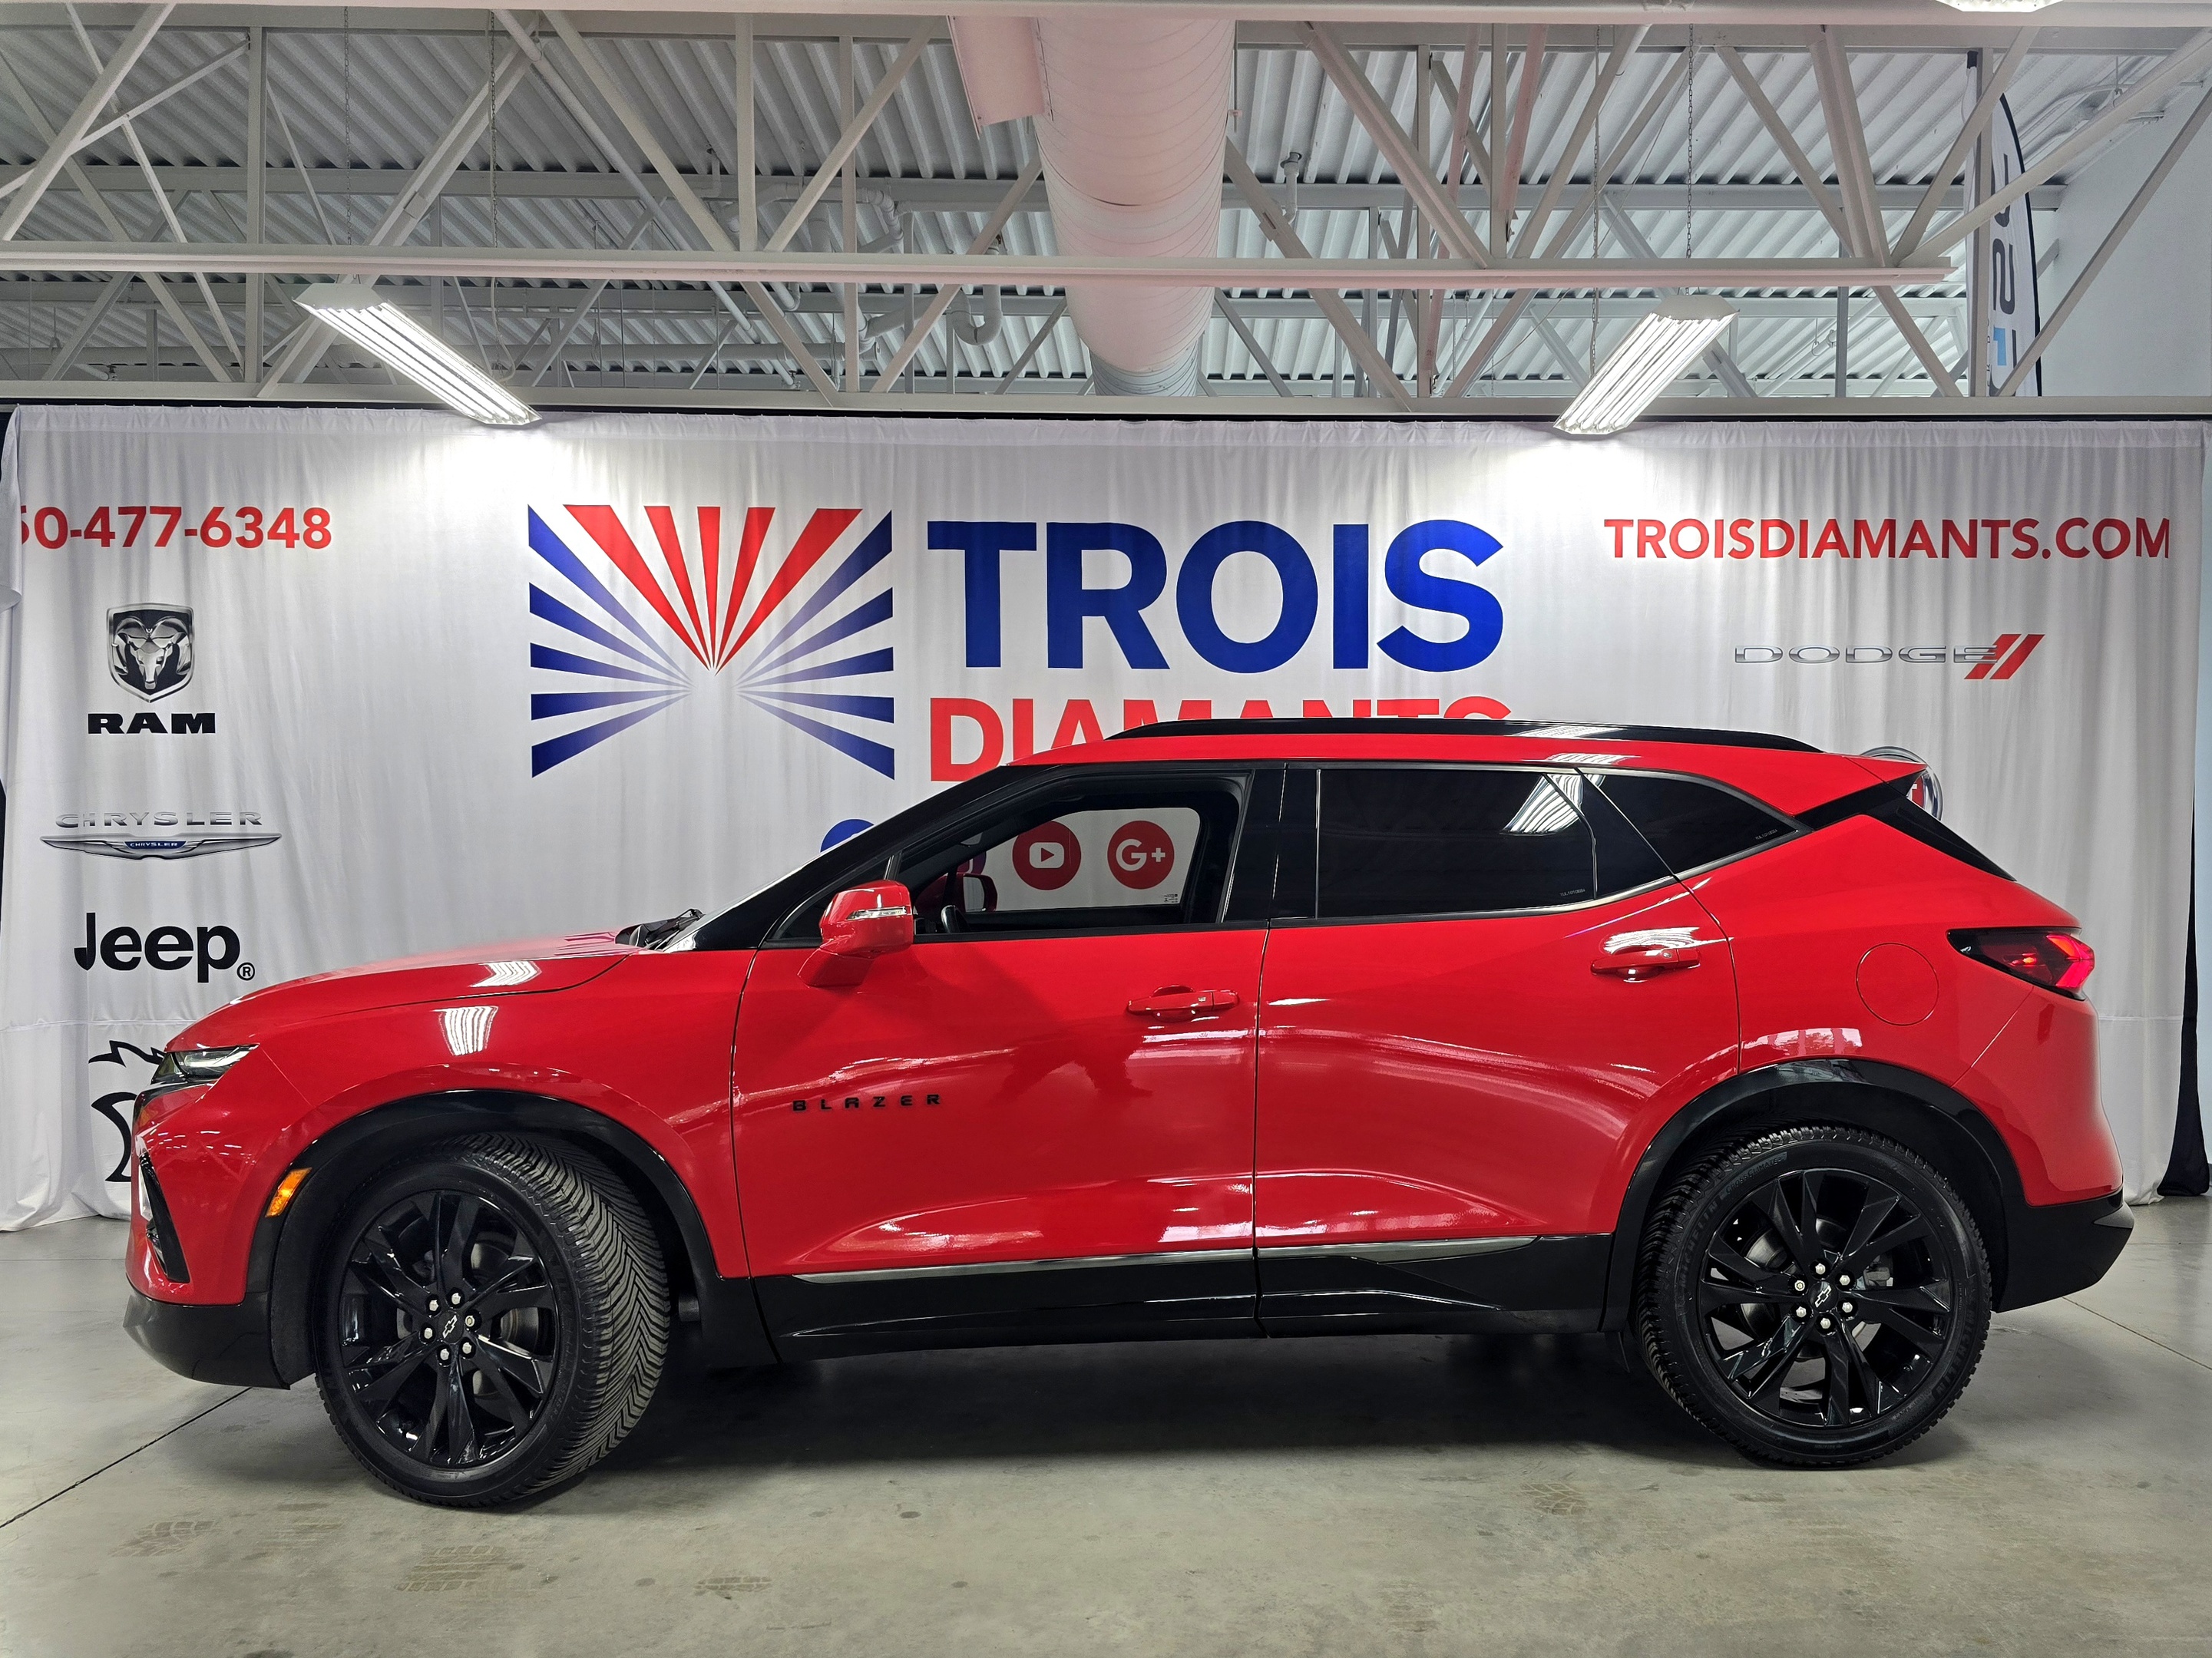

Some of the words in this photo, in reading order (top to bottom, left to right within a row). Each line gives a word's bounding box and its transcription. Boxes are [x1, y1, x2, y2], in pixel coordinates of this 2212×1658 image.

[1604, 517, 2171, 560] TROISDIAMANTS.COM
[927, 519, 1504, 673] TROIS
[1734, 644, 1999, 664] DODGE
[88, 712, 216, 735] RAM
[55, 811, 263, 828] CHRYSLER
[792, 1094, 941, 1111] BLAZER
